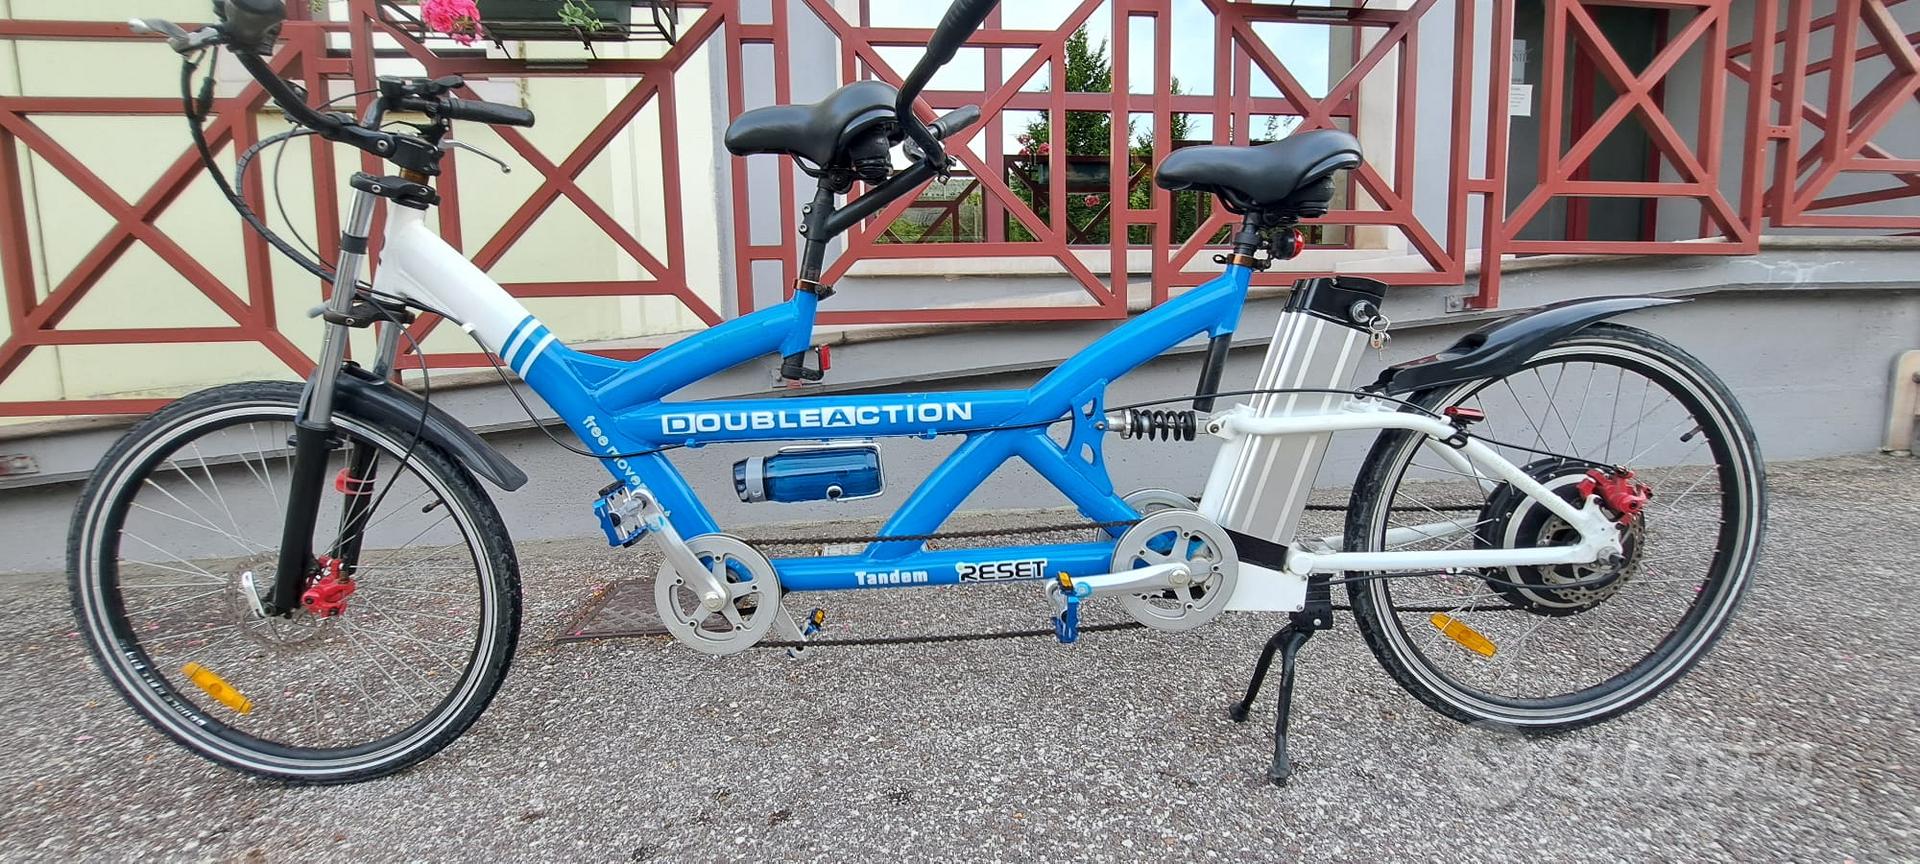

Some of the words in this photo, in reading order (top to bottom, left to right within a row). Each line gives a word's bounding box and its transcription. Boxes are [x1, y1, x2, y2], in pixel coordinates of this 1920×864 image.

[583, 415, 609, 446] free
[855, 569, 928, 586] Tandem
[960, 560, 1046, 581] RESET
